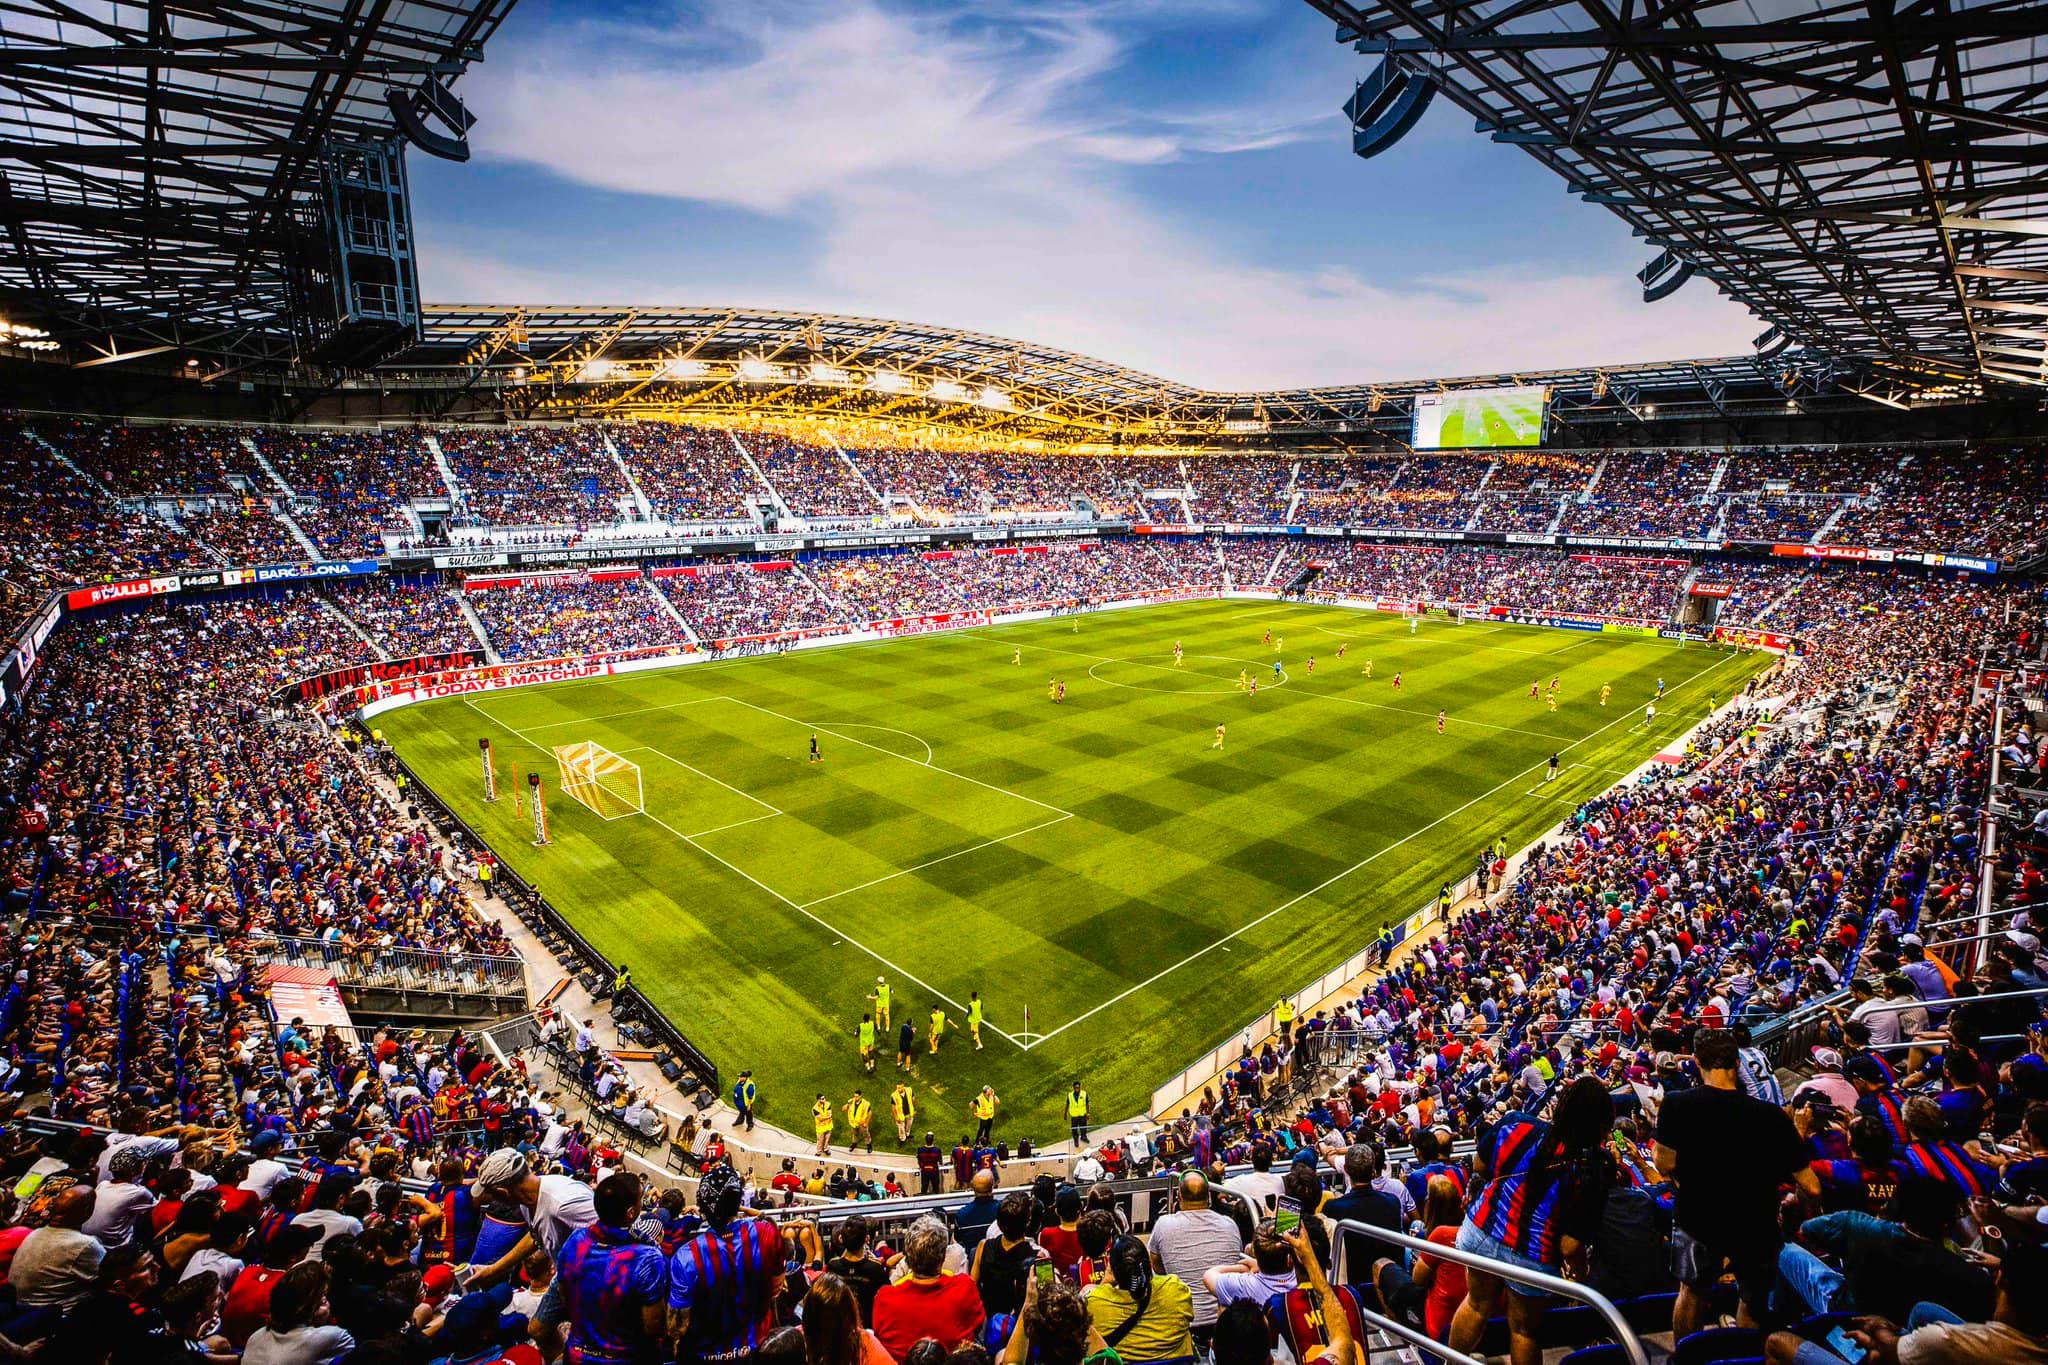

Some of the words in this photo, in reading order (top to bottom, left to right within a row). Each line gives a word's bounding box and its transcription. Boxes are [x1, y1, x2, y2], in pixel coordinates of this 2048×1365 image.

[521, 553, 535, 563] RED
[536, 552, 569, 562] MEMBERS
[569, 551, 590, 560] SCORE
[591, 550, 596, 559] A
[597, 549, 611, 559] 25%
[612, 548, 641, 558] DISCOUNT
[643, 548, 654, 556] ALL
[655, 546, 678, 556] SEASON
[678, 545, 693, 555] LONG
[1829, 548, 1866, 559] BULLS
[448, 554, 495, 567] BULLSHOP
[182, 574, 219, 587] 44:25
[888, 624, 934, 637] TODAY'S
[935, 618, 984, 631] MATCHUP
[1616, 625, 1644, 633] OANDA
[371, 658, 416, 681] Red
[424, 678, 507, 698] TODAY'S
[511, 666, 601, 686] MATCHUP
[1165, 1140, 1175, 1153] 10
[707, 1149, 716, 1159] 11
[984, 1158, 991, 1168] 5
